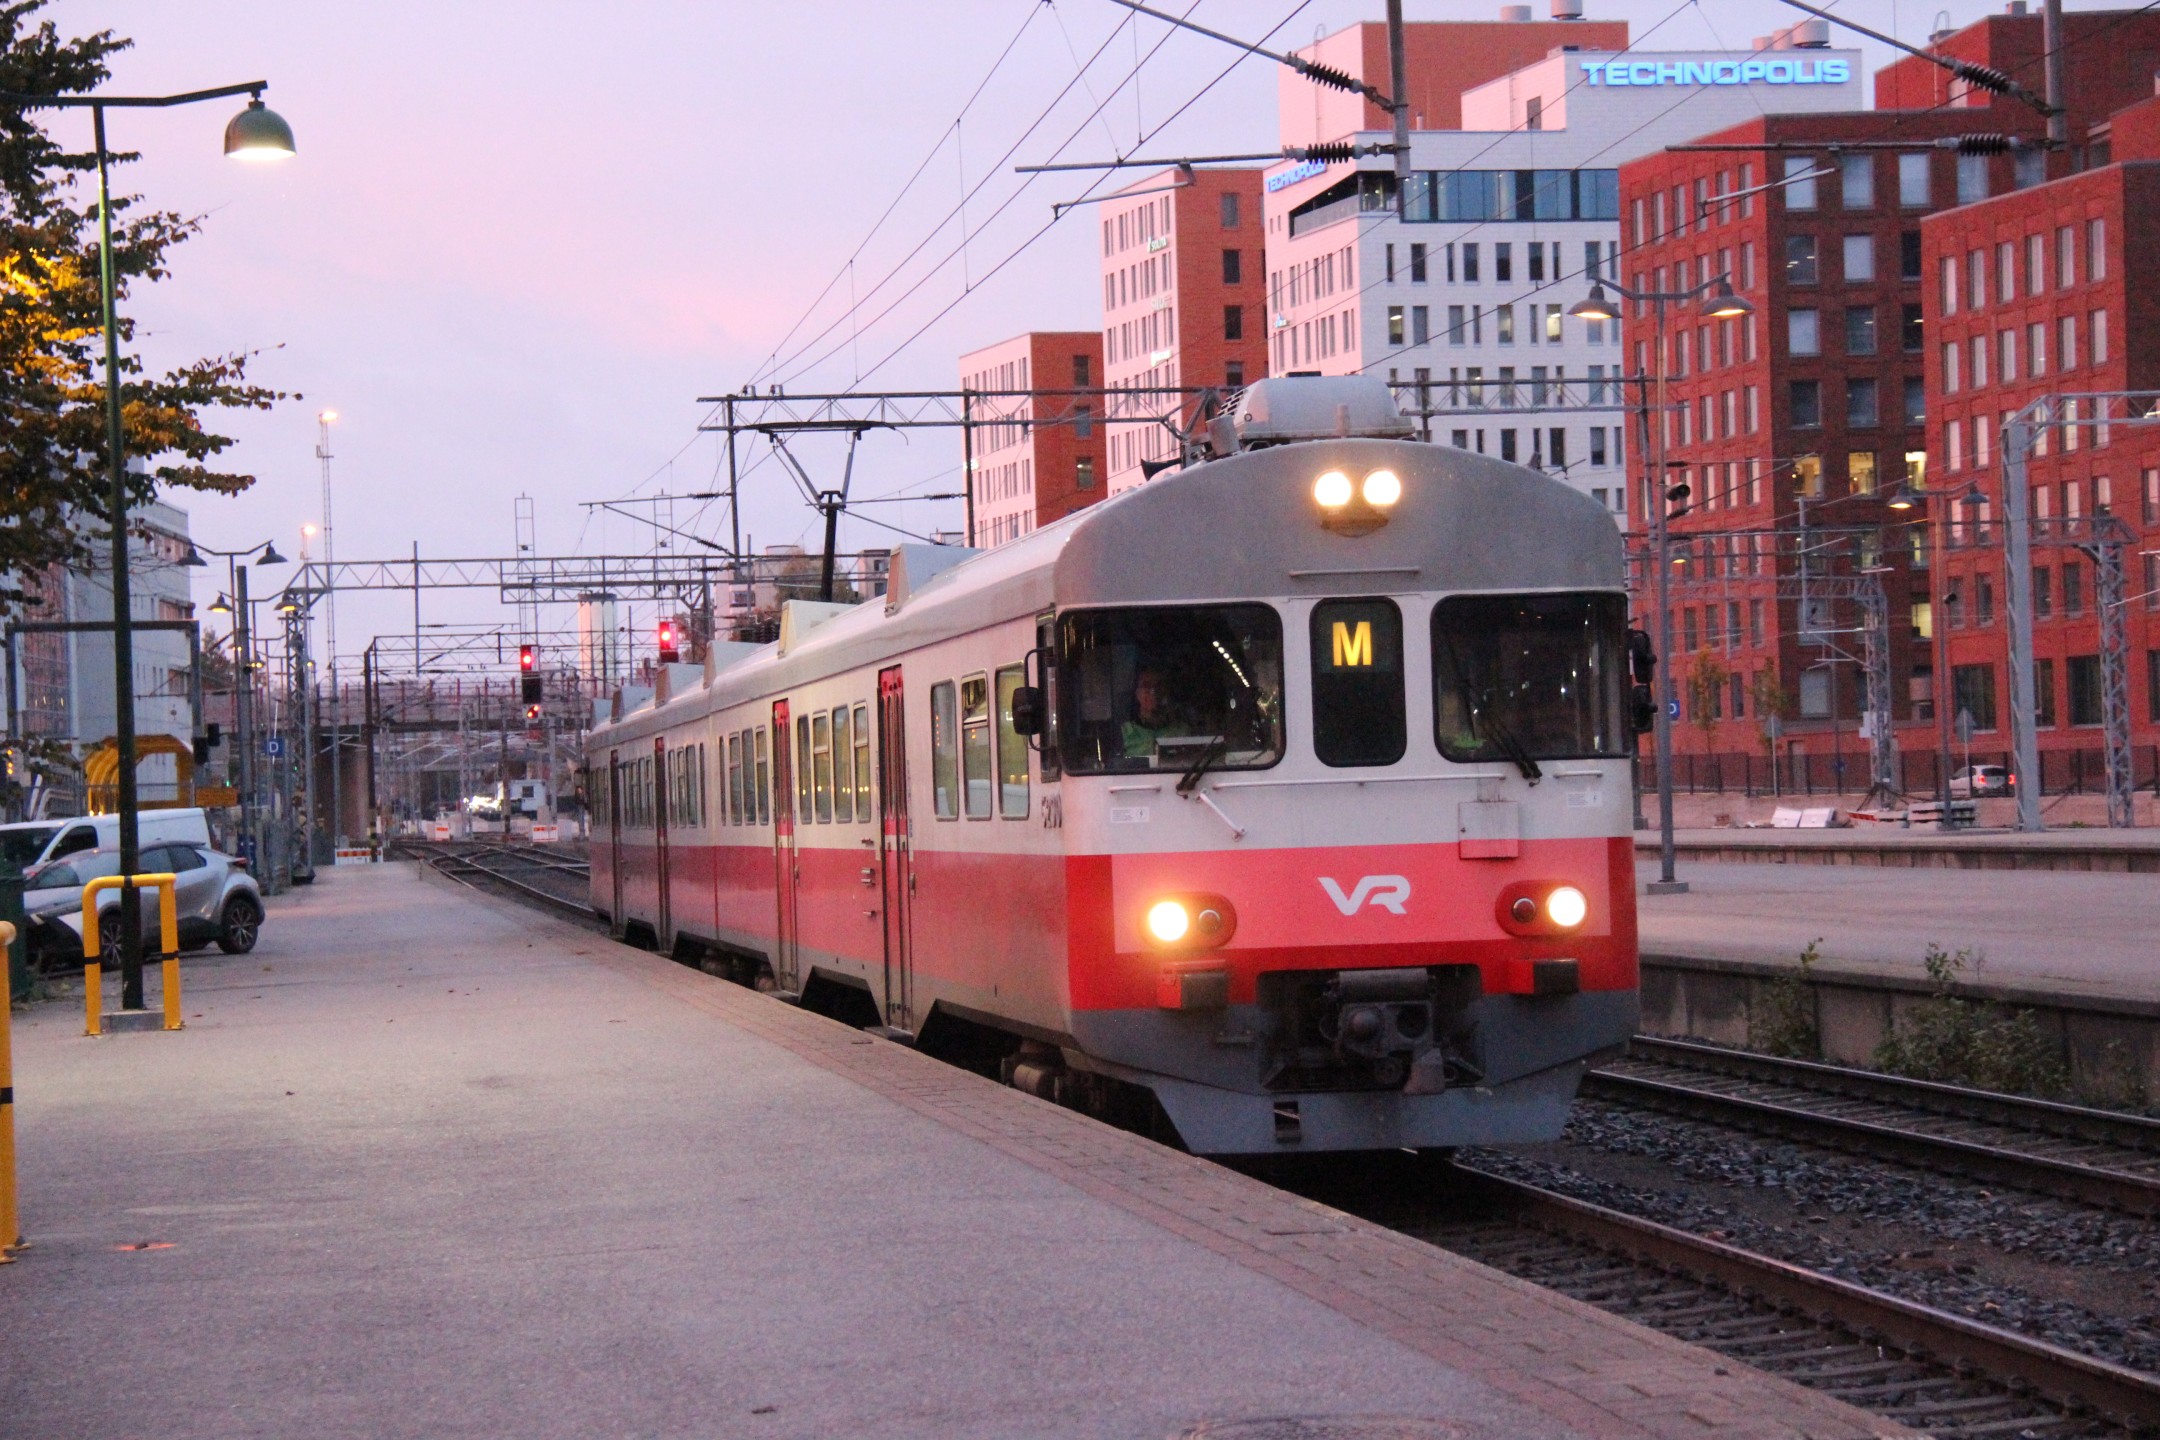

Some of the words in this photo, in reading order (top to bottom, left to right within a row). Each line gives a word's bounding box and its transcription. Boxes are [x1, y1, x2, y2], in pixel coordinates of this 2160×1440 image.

[1580, 59, 1850, 86] TECHNOPOLIS
[1332, 621, 1372, 667] M
[268, 741, 279, 753] D
[1317, 874, 1411, 916] VR
